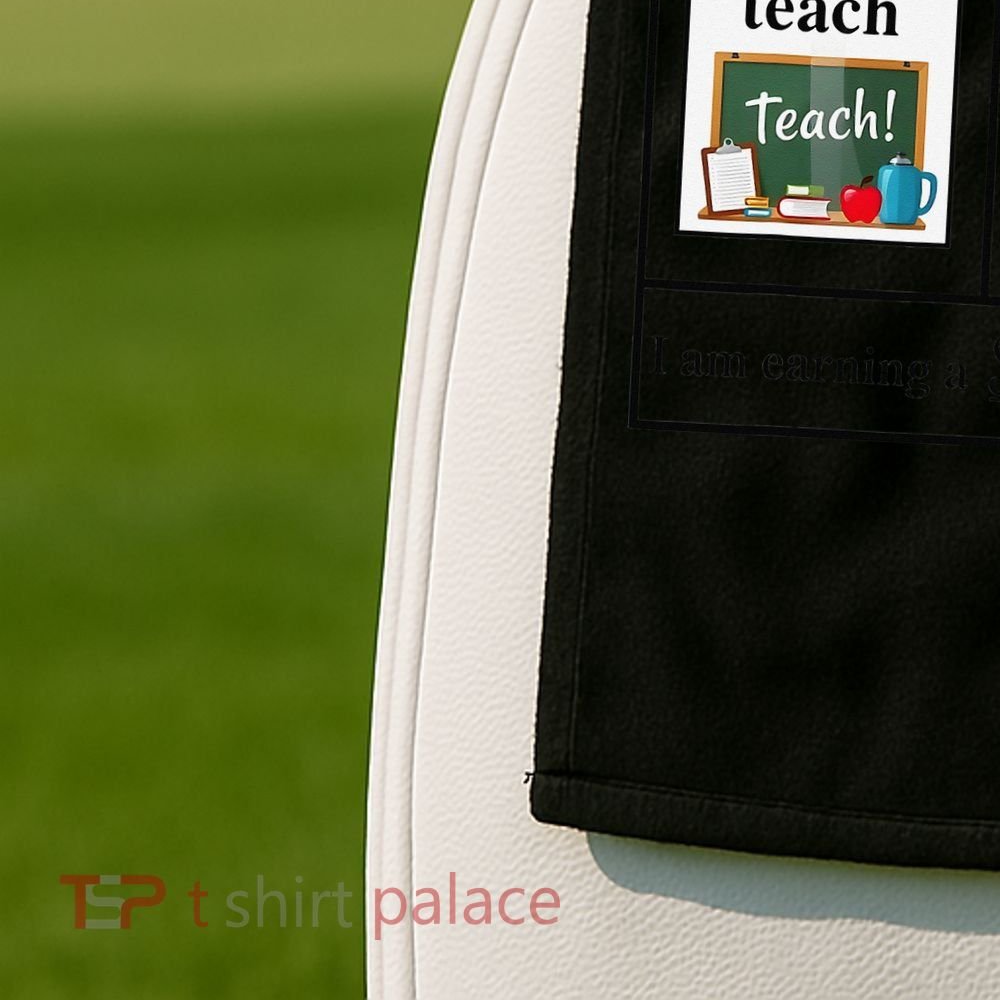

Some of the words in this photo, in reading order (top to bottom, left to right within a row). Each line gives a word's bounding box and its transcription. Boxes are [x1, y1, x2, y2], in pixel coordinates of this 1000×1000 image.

[745, 88, 897, 145] Teach!
[680, 349, 747, 378] am
[762, 346, 932, 400] earning
